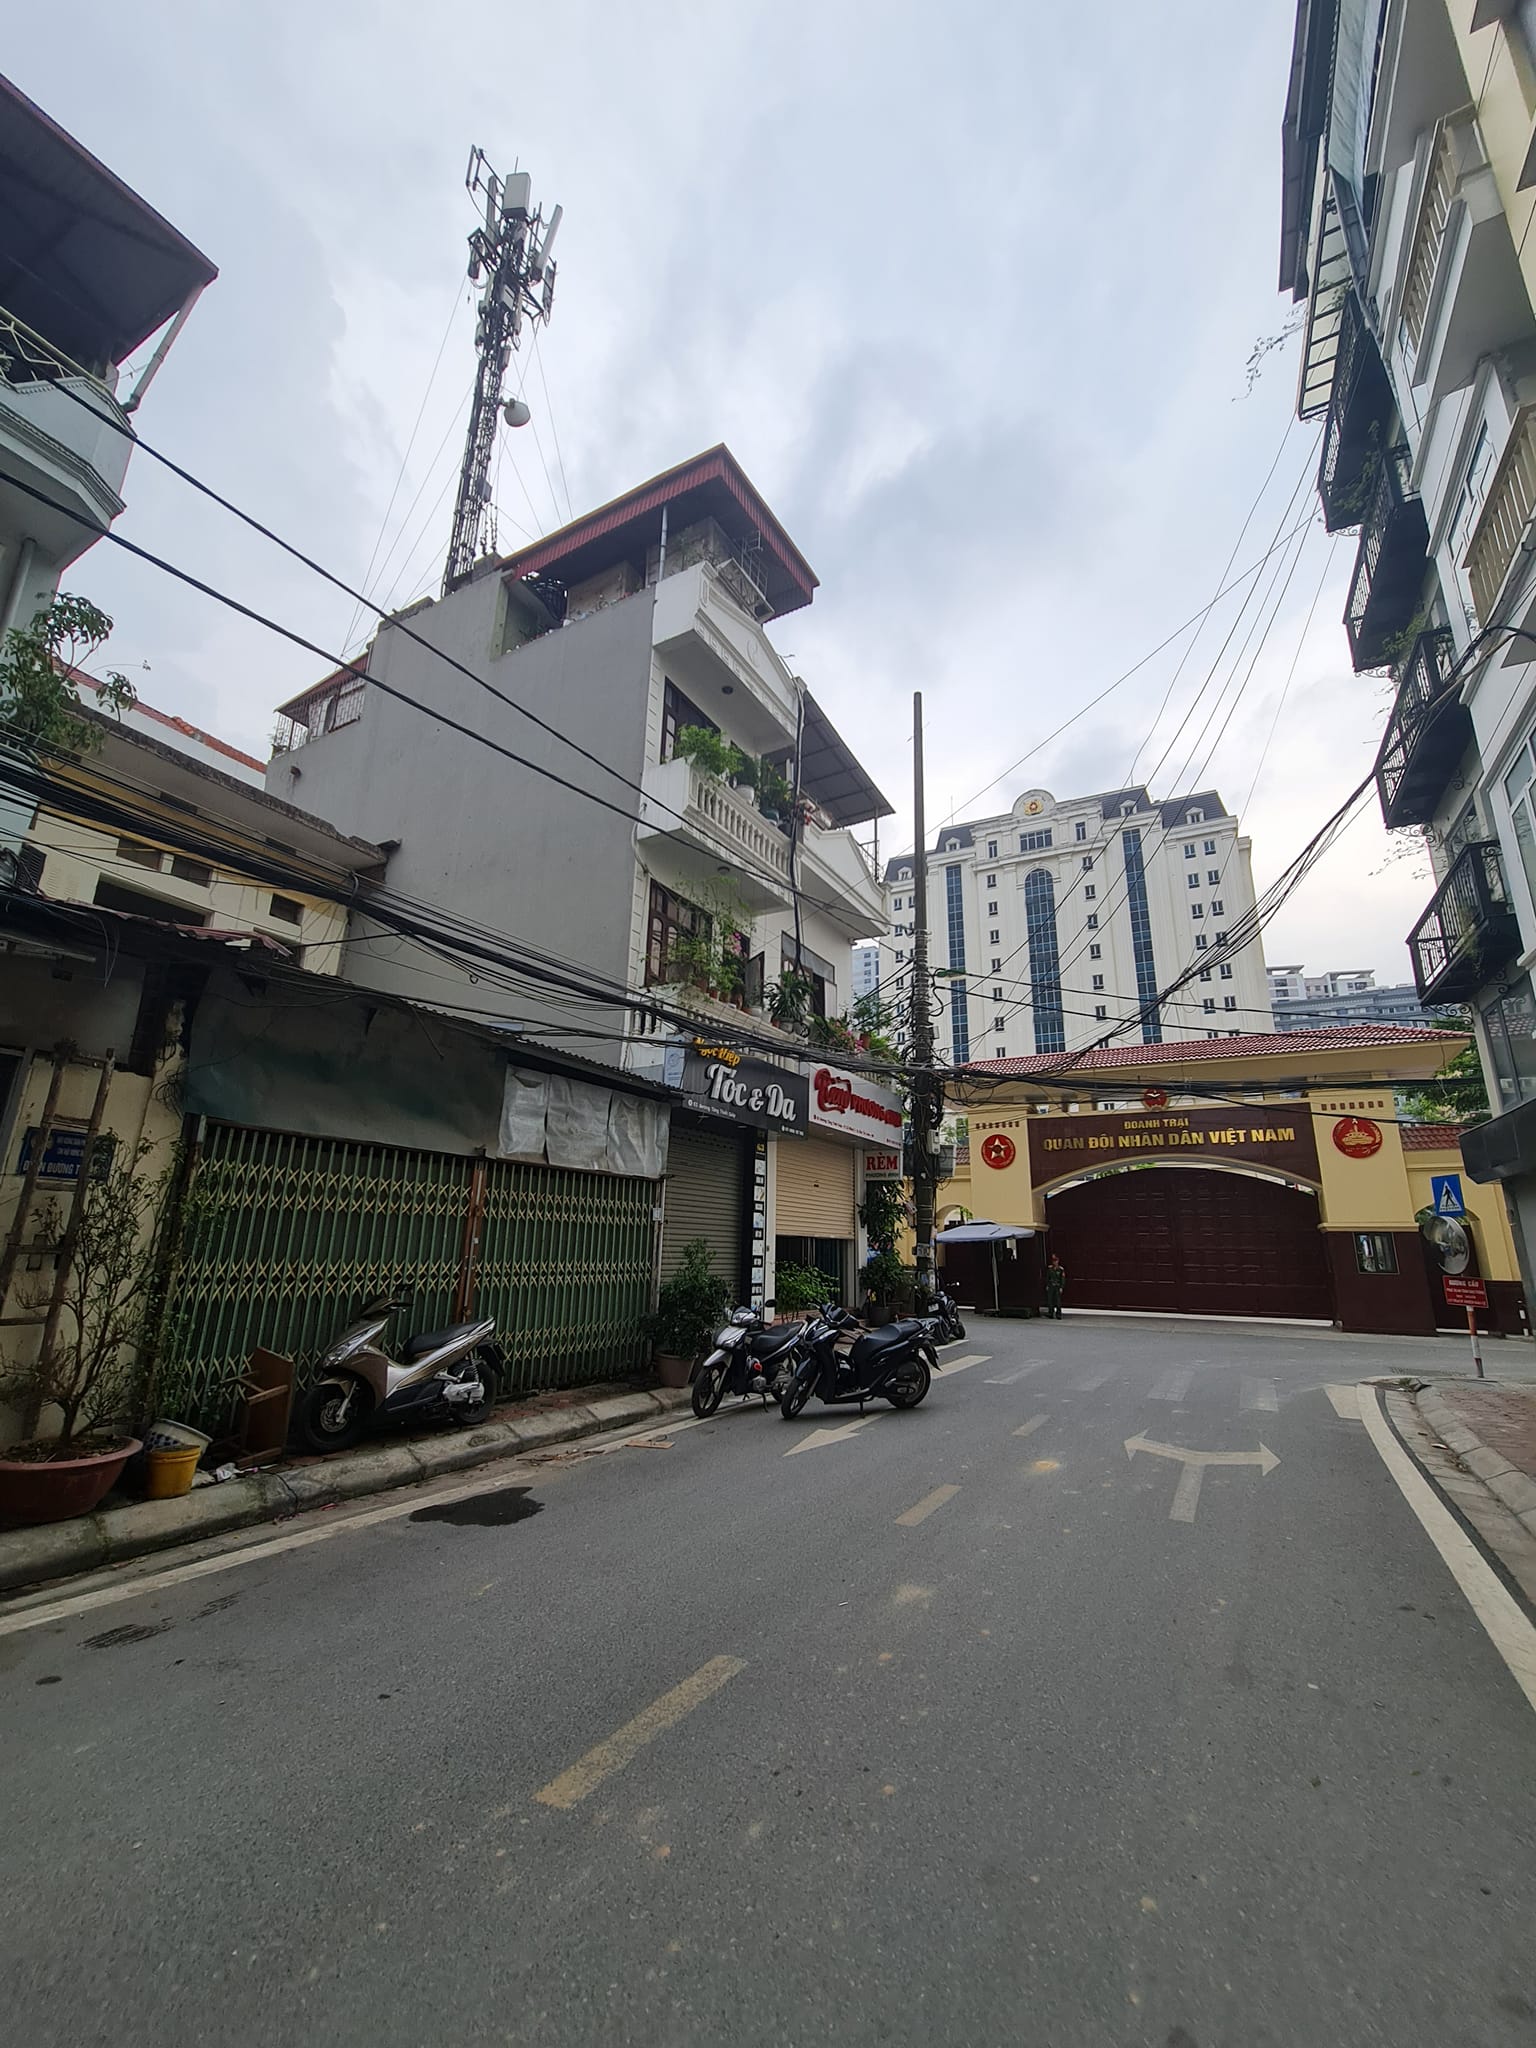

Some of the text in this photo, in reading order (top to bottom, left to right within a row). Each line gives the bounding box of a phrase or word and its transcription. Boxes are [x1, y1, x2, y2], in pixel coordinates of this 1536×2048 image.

[707, 1063, 797, 1121] Tóc & Da
[1163, 1118, 1189, 1129] TRẠI
[1088, 1134, 1115, 1151] ĐỘI
[1118, 1132, 1165, 1147] NHÂN
[1168, 1130, 1205, 1145] DÂN
[1208, 1128, 1247, 1146] VIỆT
[1251, 1128, 1296, 1142] NAM
[866, 1152, 898, 1170] RÈM
